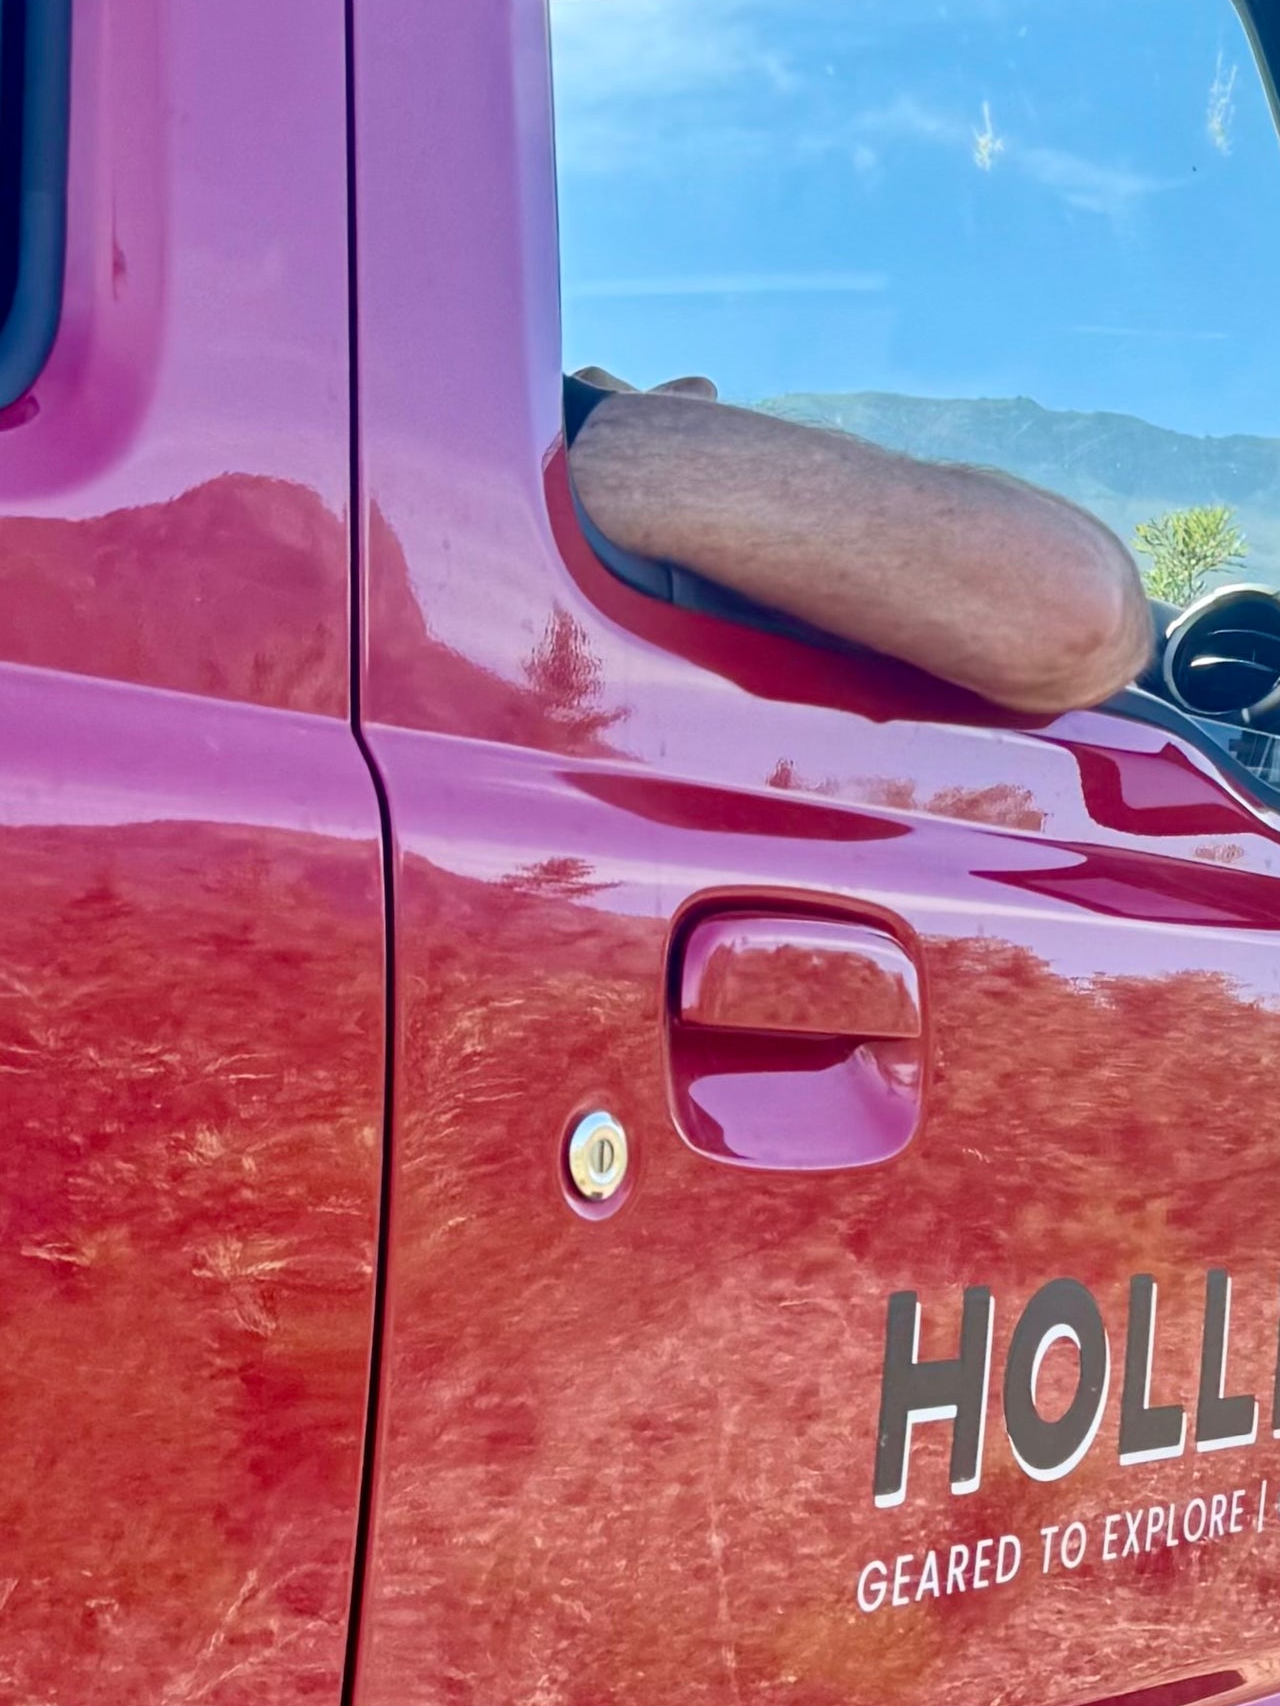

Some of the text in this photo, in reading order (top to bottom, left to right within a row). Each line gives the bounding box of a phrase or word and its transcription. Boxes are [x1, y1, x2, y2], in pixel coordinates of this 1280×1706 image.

[857, 1534, 1021, 1613] GEARED
[1040, 1521, 1087, 1574] TO
[1102, 1489, 1246, 1561] EXPLORE
